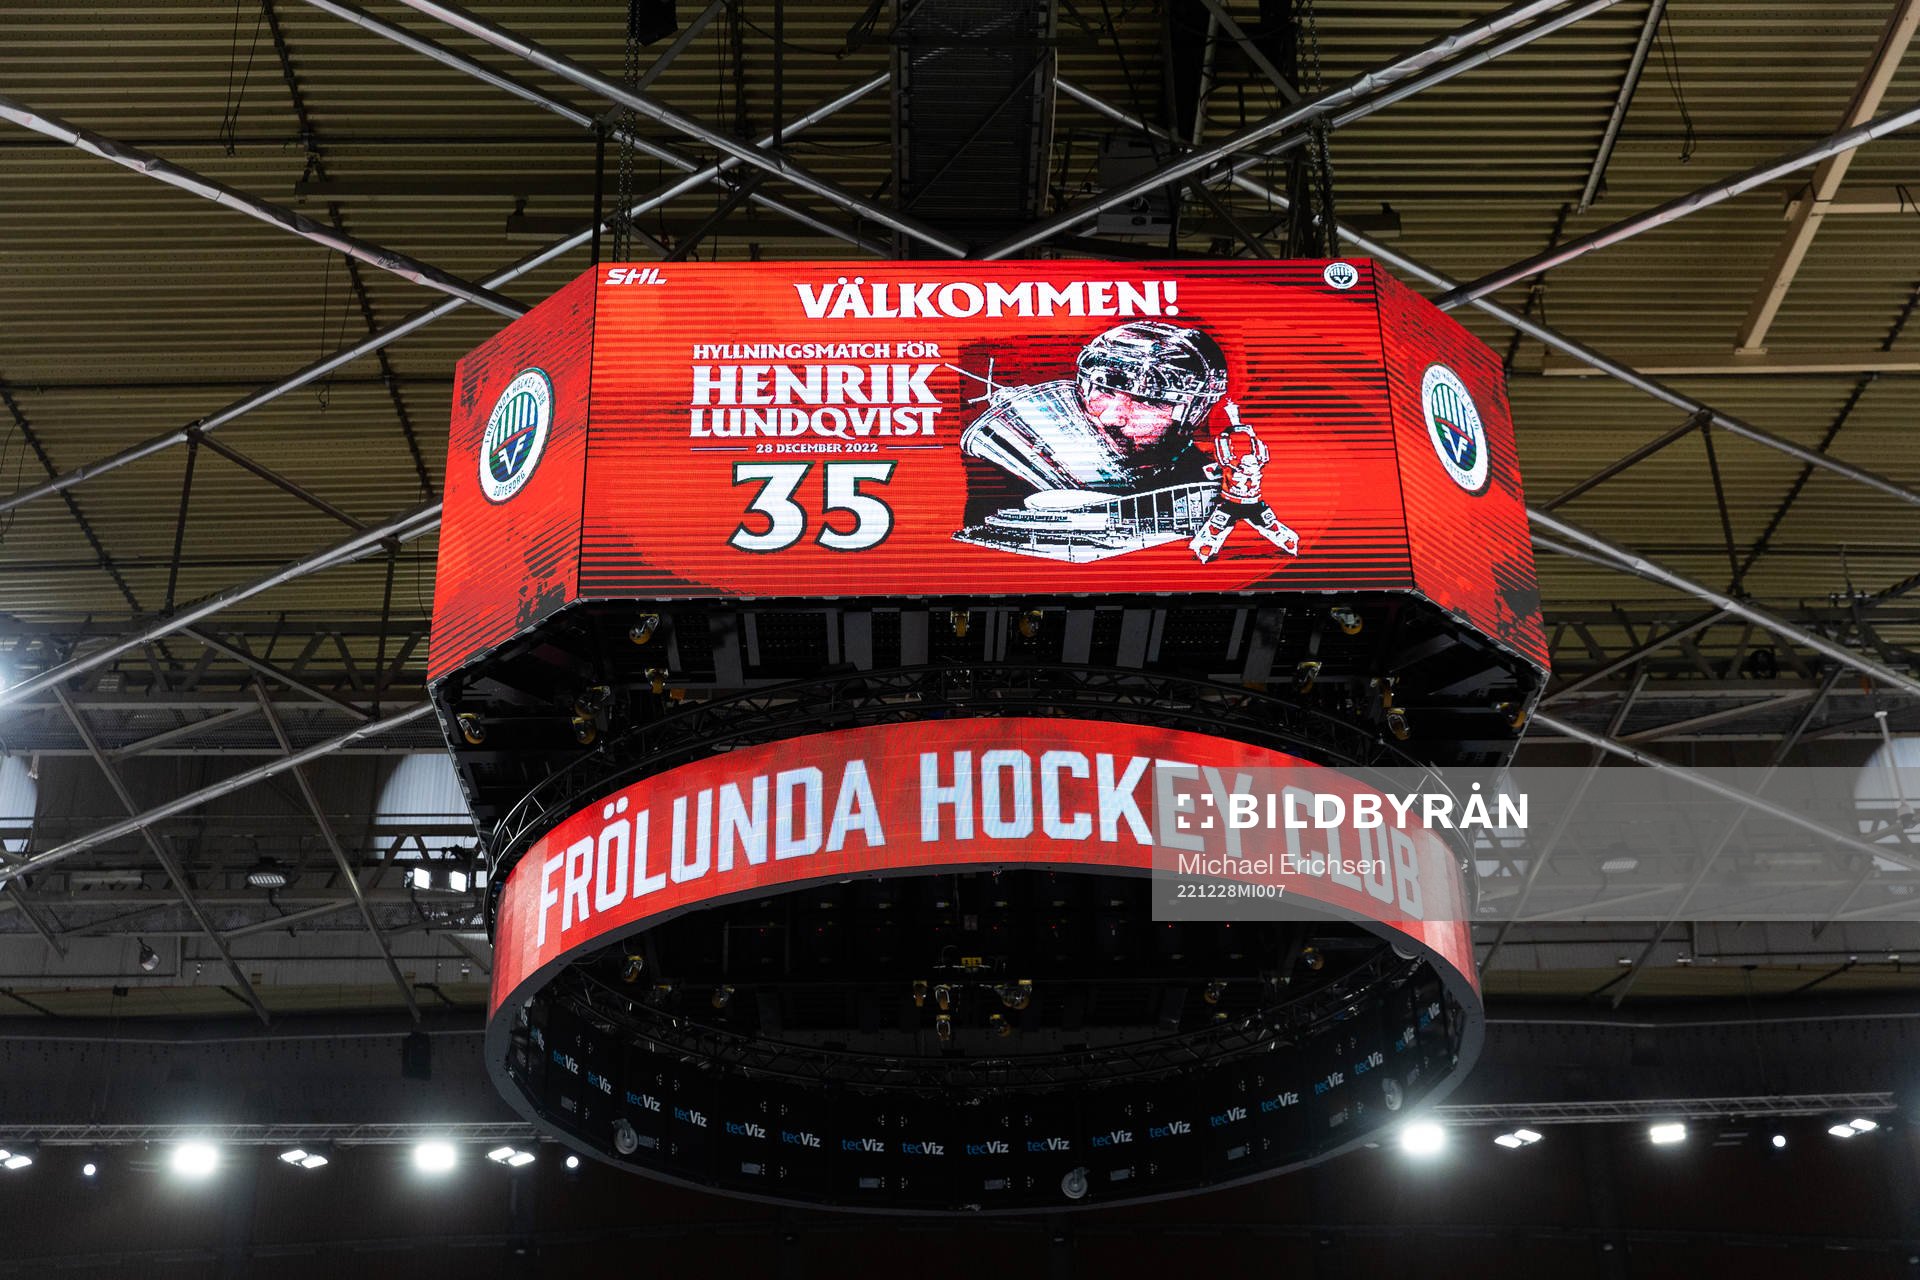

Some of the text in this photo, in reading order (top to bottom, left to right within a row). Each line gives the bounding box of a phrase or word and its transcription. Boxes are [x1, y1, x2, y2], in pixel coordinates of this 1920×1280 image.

[605, 268, 667, 285] SHL
[793, 276, 1179, 318] VÄLKOMMEN!
[692, 340, 941, 360] HYLLNINGSMATCH FÖR
[690, 364, 943, 405] HENRIK
[689, 407, 943, 440] LUNDQVIST
[756, 442, 879, 454] 28 DECEMBER 2022
[726, 460, 898, 553] 35
[537, 750, 1424, 948] FRÖLUNDA HOCKEY CLUB
[553, 1048, 579, 1075] tecViz
[1354, 1051, 1383, 1075] tecViz
[588, 1070, 611, 1095] tecViz
[1314, 1072, 1344, 1096] tecViz
[626, 1090, 660, 1113] tecViz
[1261, 1091, 1299, 1113] tecViz
[674, 1106, 707, 1128] tecViz
[1210, 1106, 1247, 1127] tecViz
[726, 1121, 765, 1139] tecViz
[782, 1129, 820, 1148] tecViz
[1092, 1130, 1133, 1148] tecViz
[1149, 1120, 1191, 1139] tecViz
[841, 1137, 884, 1153] tecViz
[902, 1141, 944, 1156] tecViz
[966, 1140, 1009, 1154] tecViz
[1027, 1137, 1070, 1152] tecViz
